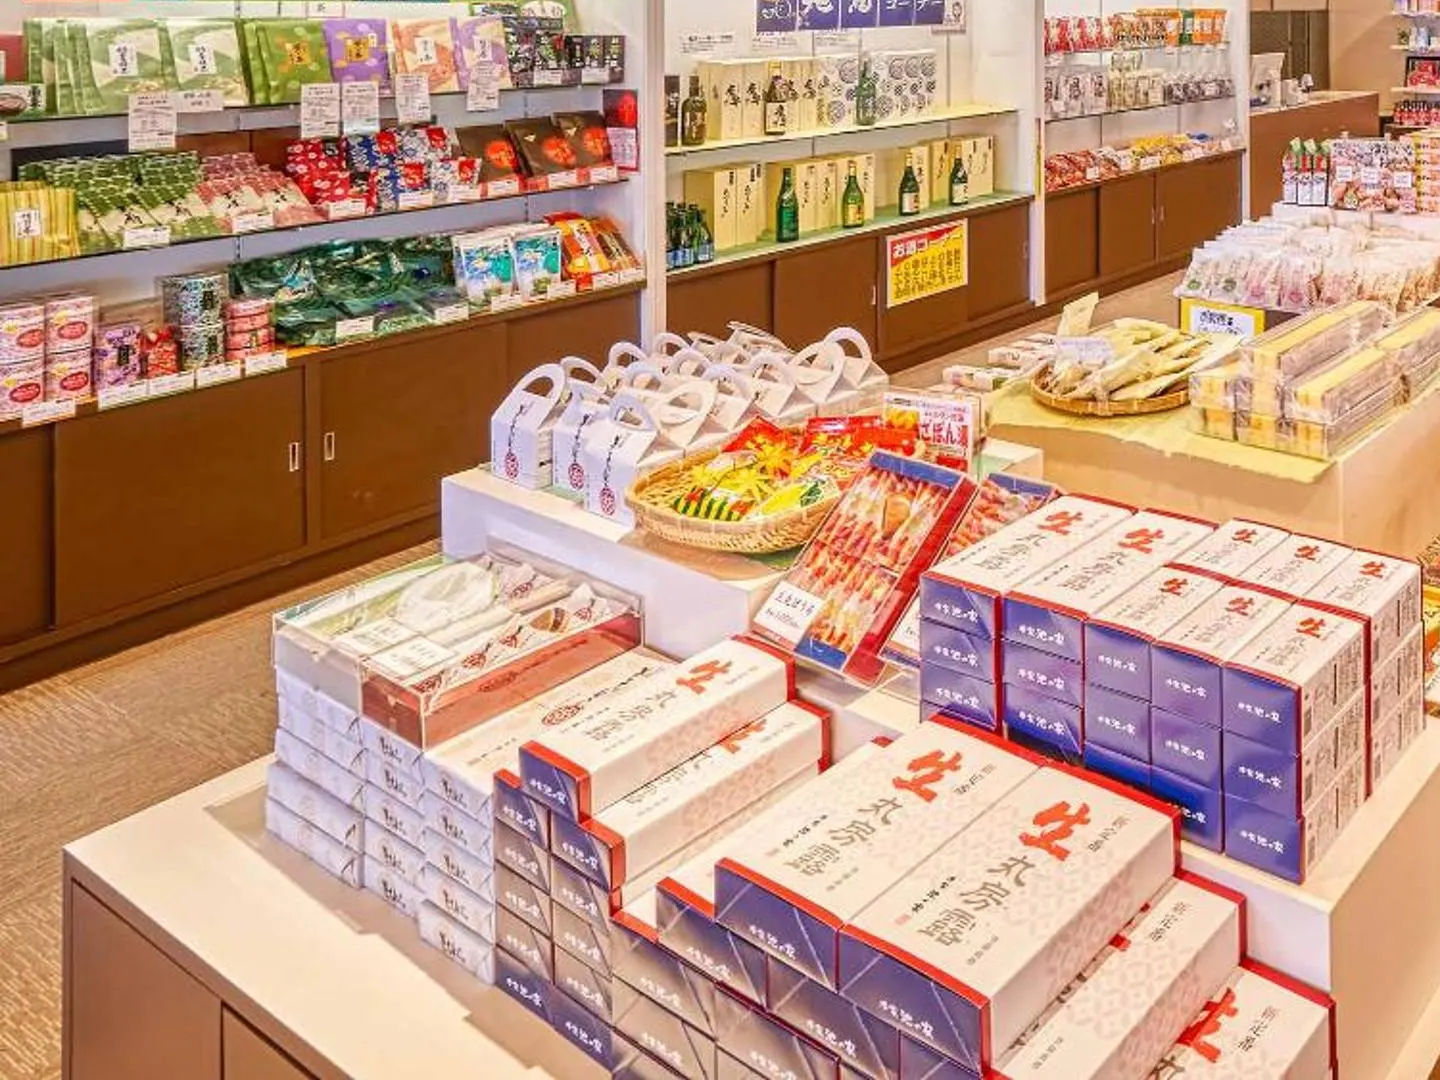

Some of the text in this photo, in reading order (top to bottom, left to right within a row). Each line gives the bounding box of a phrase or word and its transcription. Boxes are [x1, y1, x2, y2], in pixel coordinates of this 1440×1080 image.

[1037, 510, 1084, 536] 生
[1118, 527, 1165, 555] 生
[675, 658, 733, 695] 生
[784, 749, 963, 880] 生 丸房露
[1018, 800, 1092, 862] 生
[918, 854, 1037, 948] 丸房露
